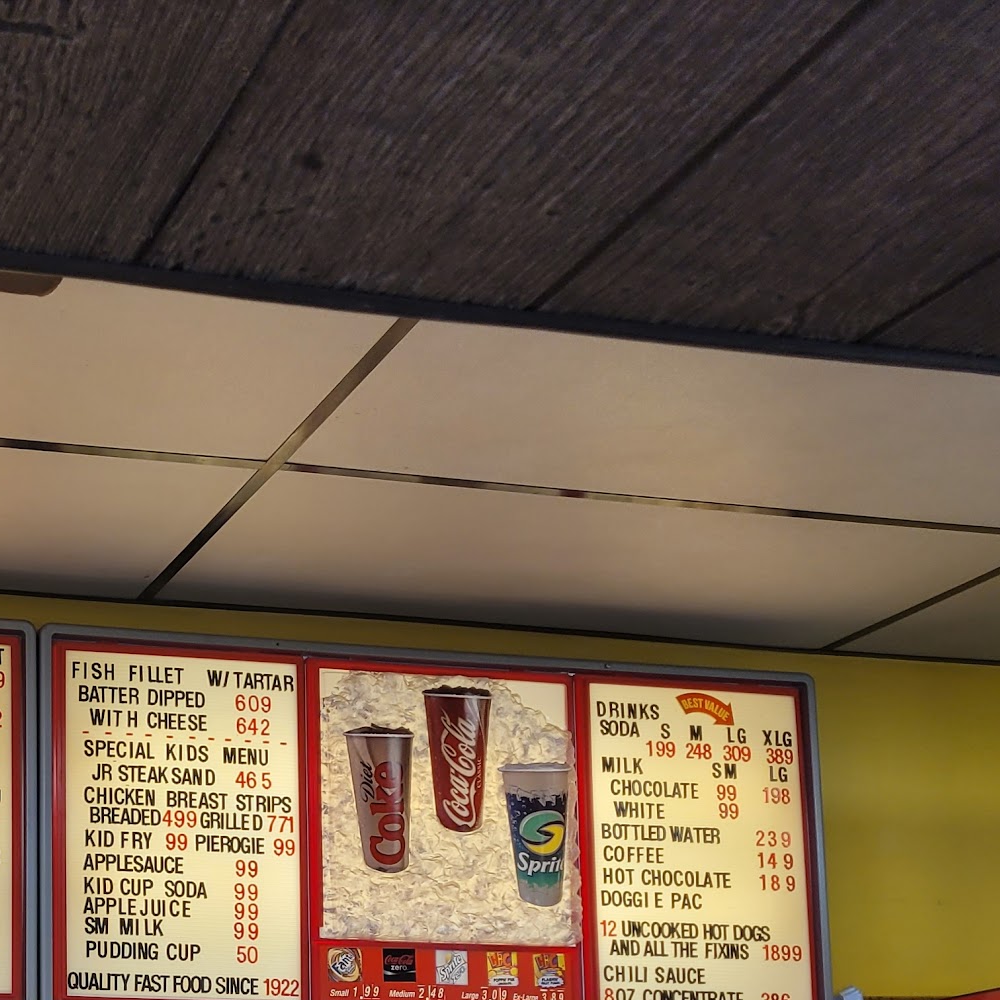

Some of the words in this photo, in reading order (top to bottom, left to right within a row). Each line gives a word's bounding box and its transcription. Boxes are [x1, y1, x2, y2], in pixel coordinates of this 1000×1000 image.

[597, 701, 659, 720] DRINKS
[681, 698, 703, 710] BEST
[704, 699, 730, 721] VALUE
[84, 740, 154, 760] SPECIAL
[167, 743, 208, 762] KIDS
[223, 747, 268, 766] MENU
[84, 787, 155, 806] CHICKEN
[167, 790, 227, 810] BREAST
[236, 794, 291, 813] STRIPS
[611, 779, 698, 799] CHOCOLATE
[717, 784, 736, 801] 99
[762, 787, 790, 804] 198
[362, 761, 372, 803] Diet
[370, 761, 404, 866] Coke
[602, 823, 666, 841] BOTTLED
[670, 826, 720, 844] WATER
[756, 830, 791, 847] 239
[83, 854, 184, 874] APPLESAUCE
[235, 860, 258, 878] 99
[600, 920, 617, 937] 12
[622, 921, 698, 939] UNCOOKED
[703, 923, 729, 941] HOT
[733, 925, 770, 942] DOGS
[68, 972, 130, 990] QUALITY
[135, 975, 170, 993] FAST
[173, 976, 211, 994] FOOD
[216, 977, 259, 995] SINCE
[263, 979, 299, 997] 1922
